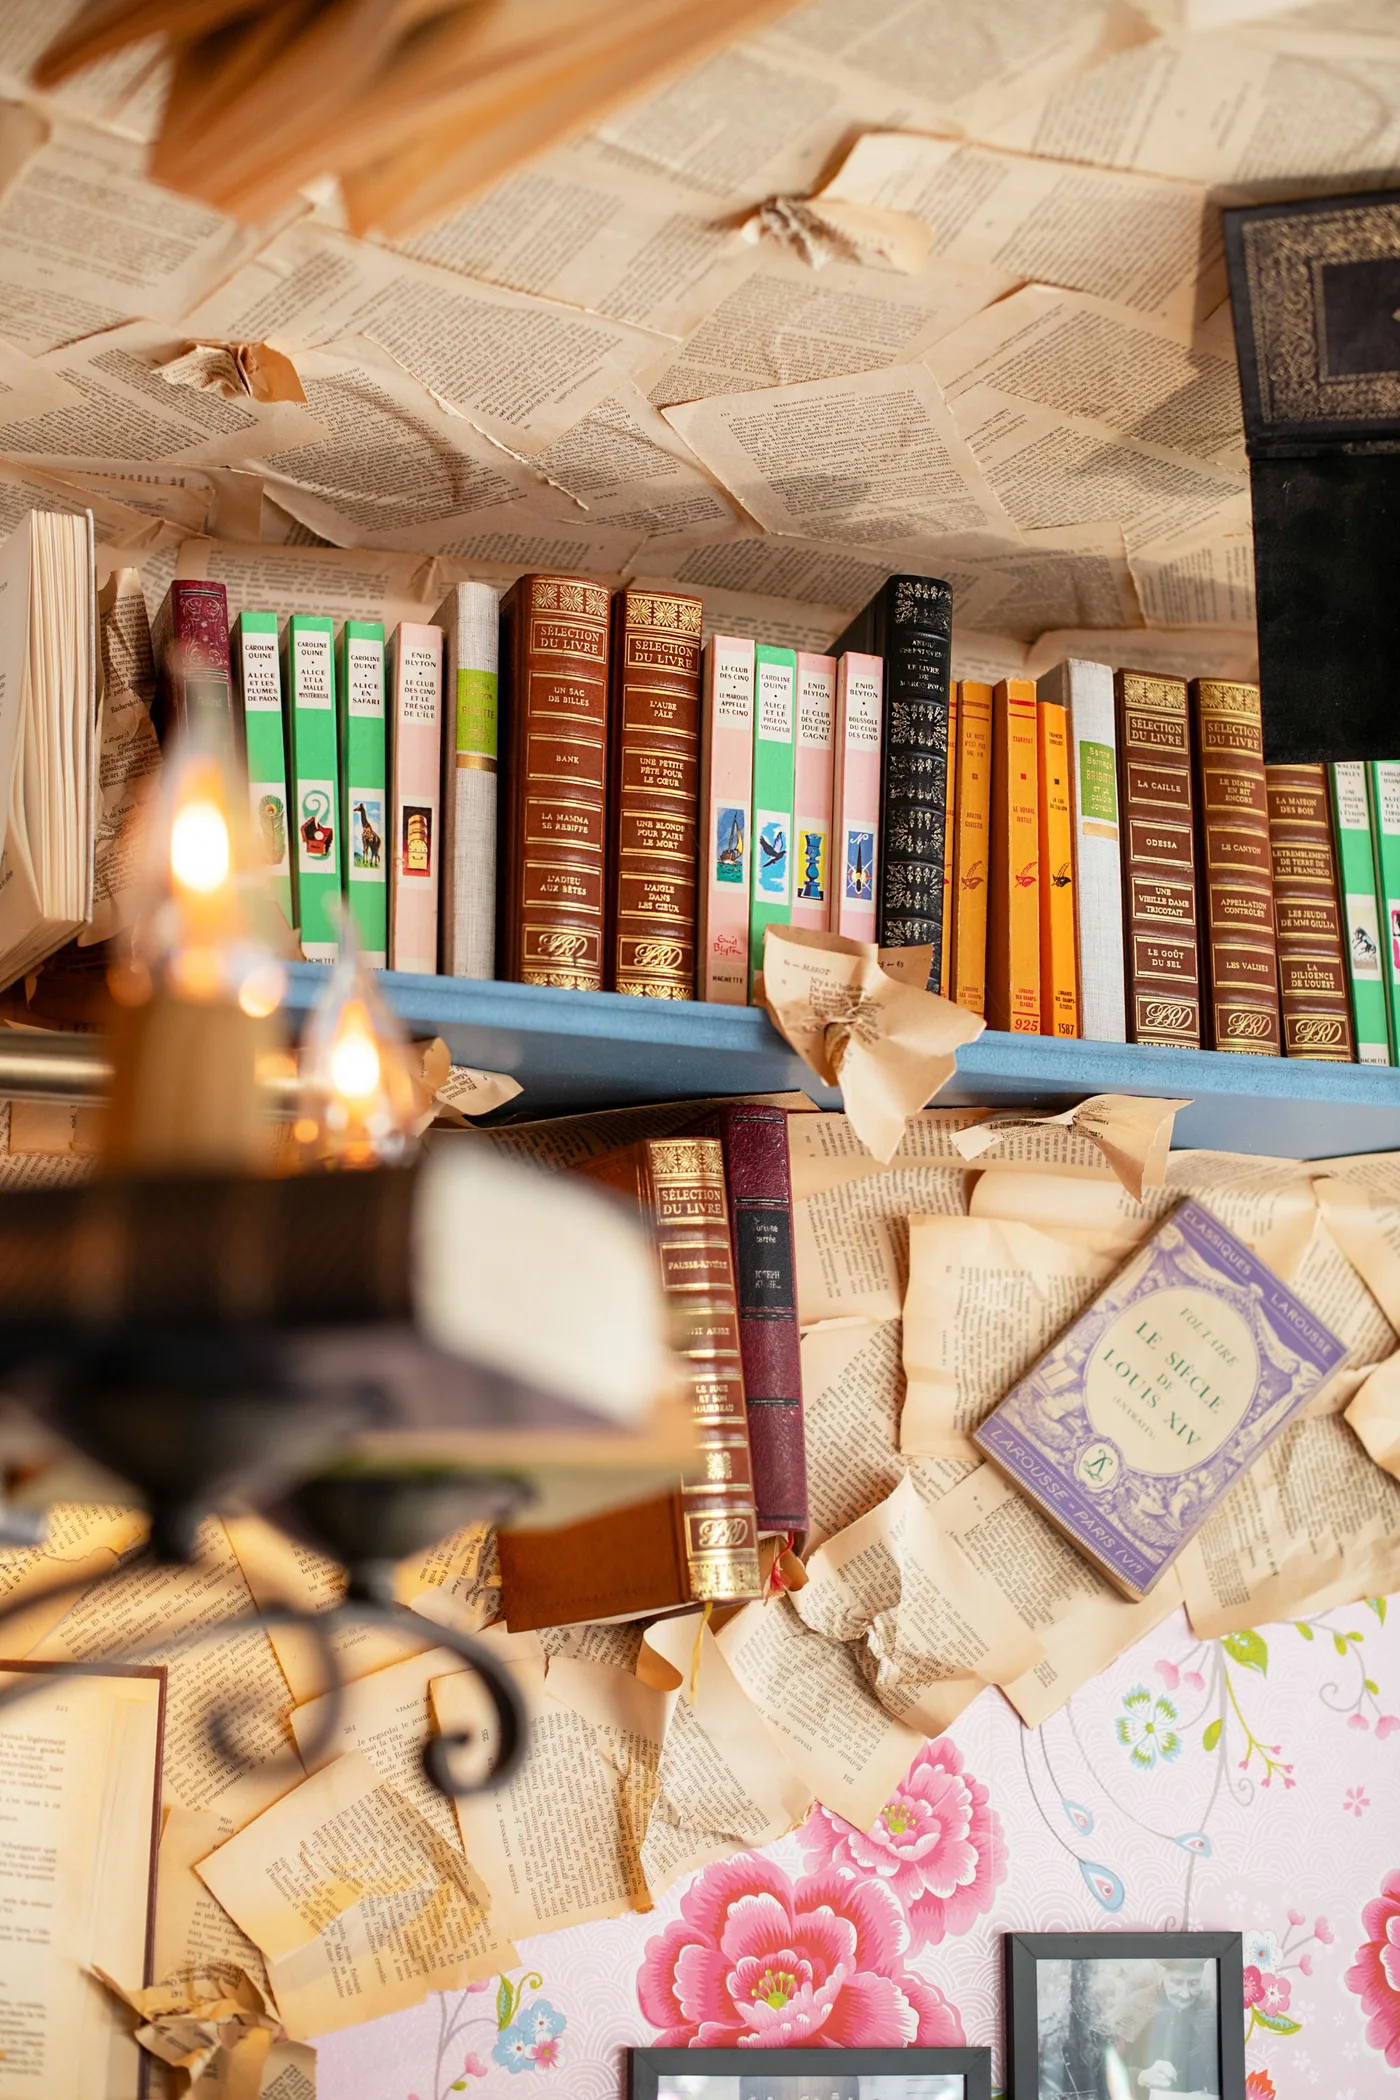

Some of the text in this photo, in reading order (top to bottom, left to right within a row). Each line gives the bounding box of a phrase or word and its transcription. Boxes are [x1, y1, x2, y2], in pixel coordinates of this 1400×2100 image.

[541, 627, 599, 642] SÉLECTION
[541, 638, 598, 654] DU LIVRE
[636, 641, 693, 657] SÉLECTION
[635, 653, 692, 668] DU LIVRE
[761, 674, 790, 683] CAROLINE
[856, 682, 873, 690] ENID
[569, 688, 584, 696] SAC
[803, 690, 830, 698] BLYTON
[850, 690, 878, 698] BLYTON
[353, 697, 379, 705] SAFARI
[563, 697, 589, 706] BILLES
[727, 693, 748, 701] MARQUIS
[650, 701, 677, 710] L'AUBE
[764, 701, 787, 710] ALICE
[417, 711, 435, 719] L'ÎLE
[654, 709, 673, 719] PÂLE
[732, 709, 748, 717] CINQ
[812, 710, 829, 718] CLUB
[764, 717, 787, 725] PIGEON
[815, 718, 831, 726] CINQ
[849, 717, 878, 725] BOUSSOLE
[761, 724, 790, 733] VOYAGEUR
[860, 725, 877, 733] CLUB
[1132, 719, 1181, 734] SÉLECTION
[1208, 723, 1259, 738] SÉLECTION
[803, 732, 828, 741] GAGNE
[863, 733, 878, 741] CINQ
[1132, 730, 1181, 745] DU LIVRE
[1209, 736, 1259, 749] DU LIVRE
[556, 755, 579, 764] BANK
[1138, 780, 1181, 792] LA CAILLE
[1232, 780, 1255, 789] DIABLE
[1276, 797, 1316, 806] LA MAISON
[1298, 807, 1314, 815] BOIS
[557, 814, 588, 824] MAMMA
[656, 840, 678, 849] MORT
[1146, 839, 1177, 849] ODESSA
[1234, 844, 1261, 854] CANYON
[547, 876, 580, 885] L'ADIEU
[645, 884, 675, 893] L'AIGLE
[649, 892, 670, 901] DANS
[1139, 895, 1189, 907] VIEILLE DAME
[1221, 899, 1266, 910] APPELLATION
[1146, 905, 1183, 916] TRICOTAIT
[1225, 906, 1264, 918] CONTRÔLÉE
[714, 943, 742, 955] Blyton
[1161, 950, 1184, 959] GOÛT
[1242, 962, 1268, 972] VALISES
[712, 975, 743, 983] HACHETTE
[1291, 972, 1333, 980] DILIGENCE
[1304, 980, 1334, 988] L'OUEST
[1015, 1018, 1038, 1032] 925
[1058, 1023, 1074, 1035] 1587
[662, 1189, 721, 1201] SÉLECTION
[663, 1204, 721, 1214] DU LIVRE
[1183, 1209, 1332, 1355] CLASSIQUES LAROUSSE
[1180, 1308, 1239, 1367] VOLTAIRE
[1136, 1321, 1225, 1414] LE SIÈCLE
[1156, 1373, 1173, 1392] DE
[1102, 1348, 1203, 1447] LOUIS XIV
[989, 1430, 1116, 1550] LAROUSSE PARIS
[369, 1725, 398, 1742] regardai
[412, 1713, 431, 1726] jeune
